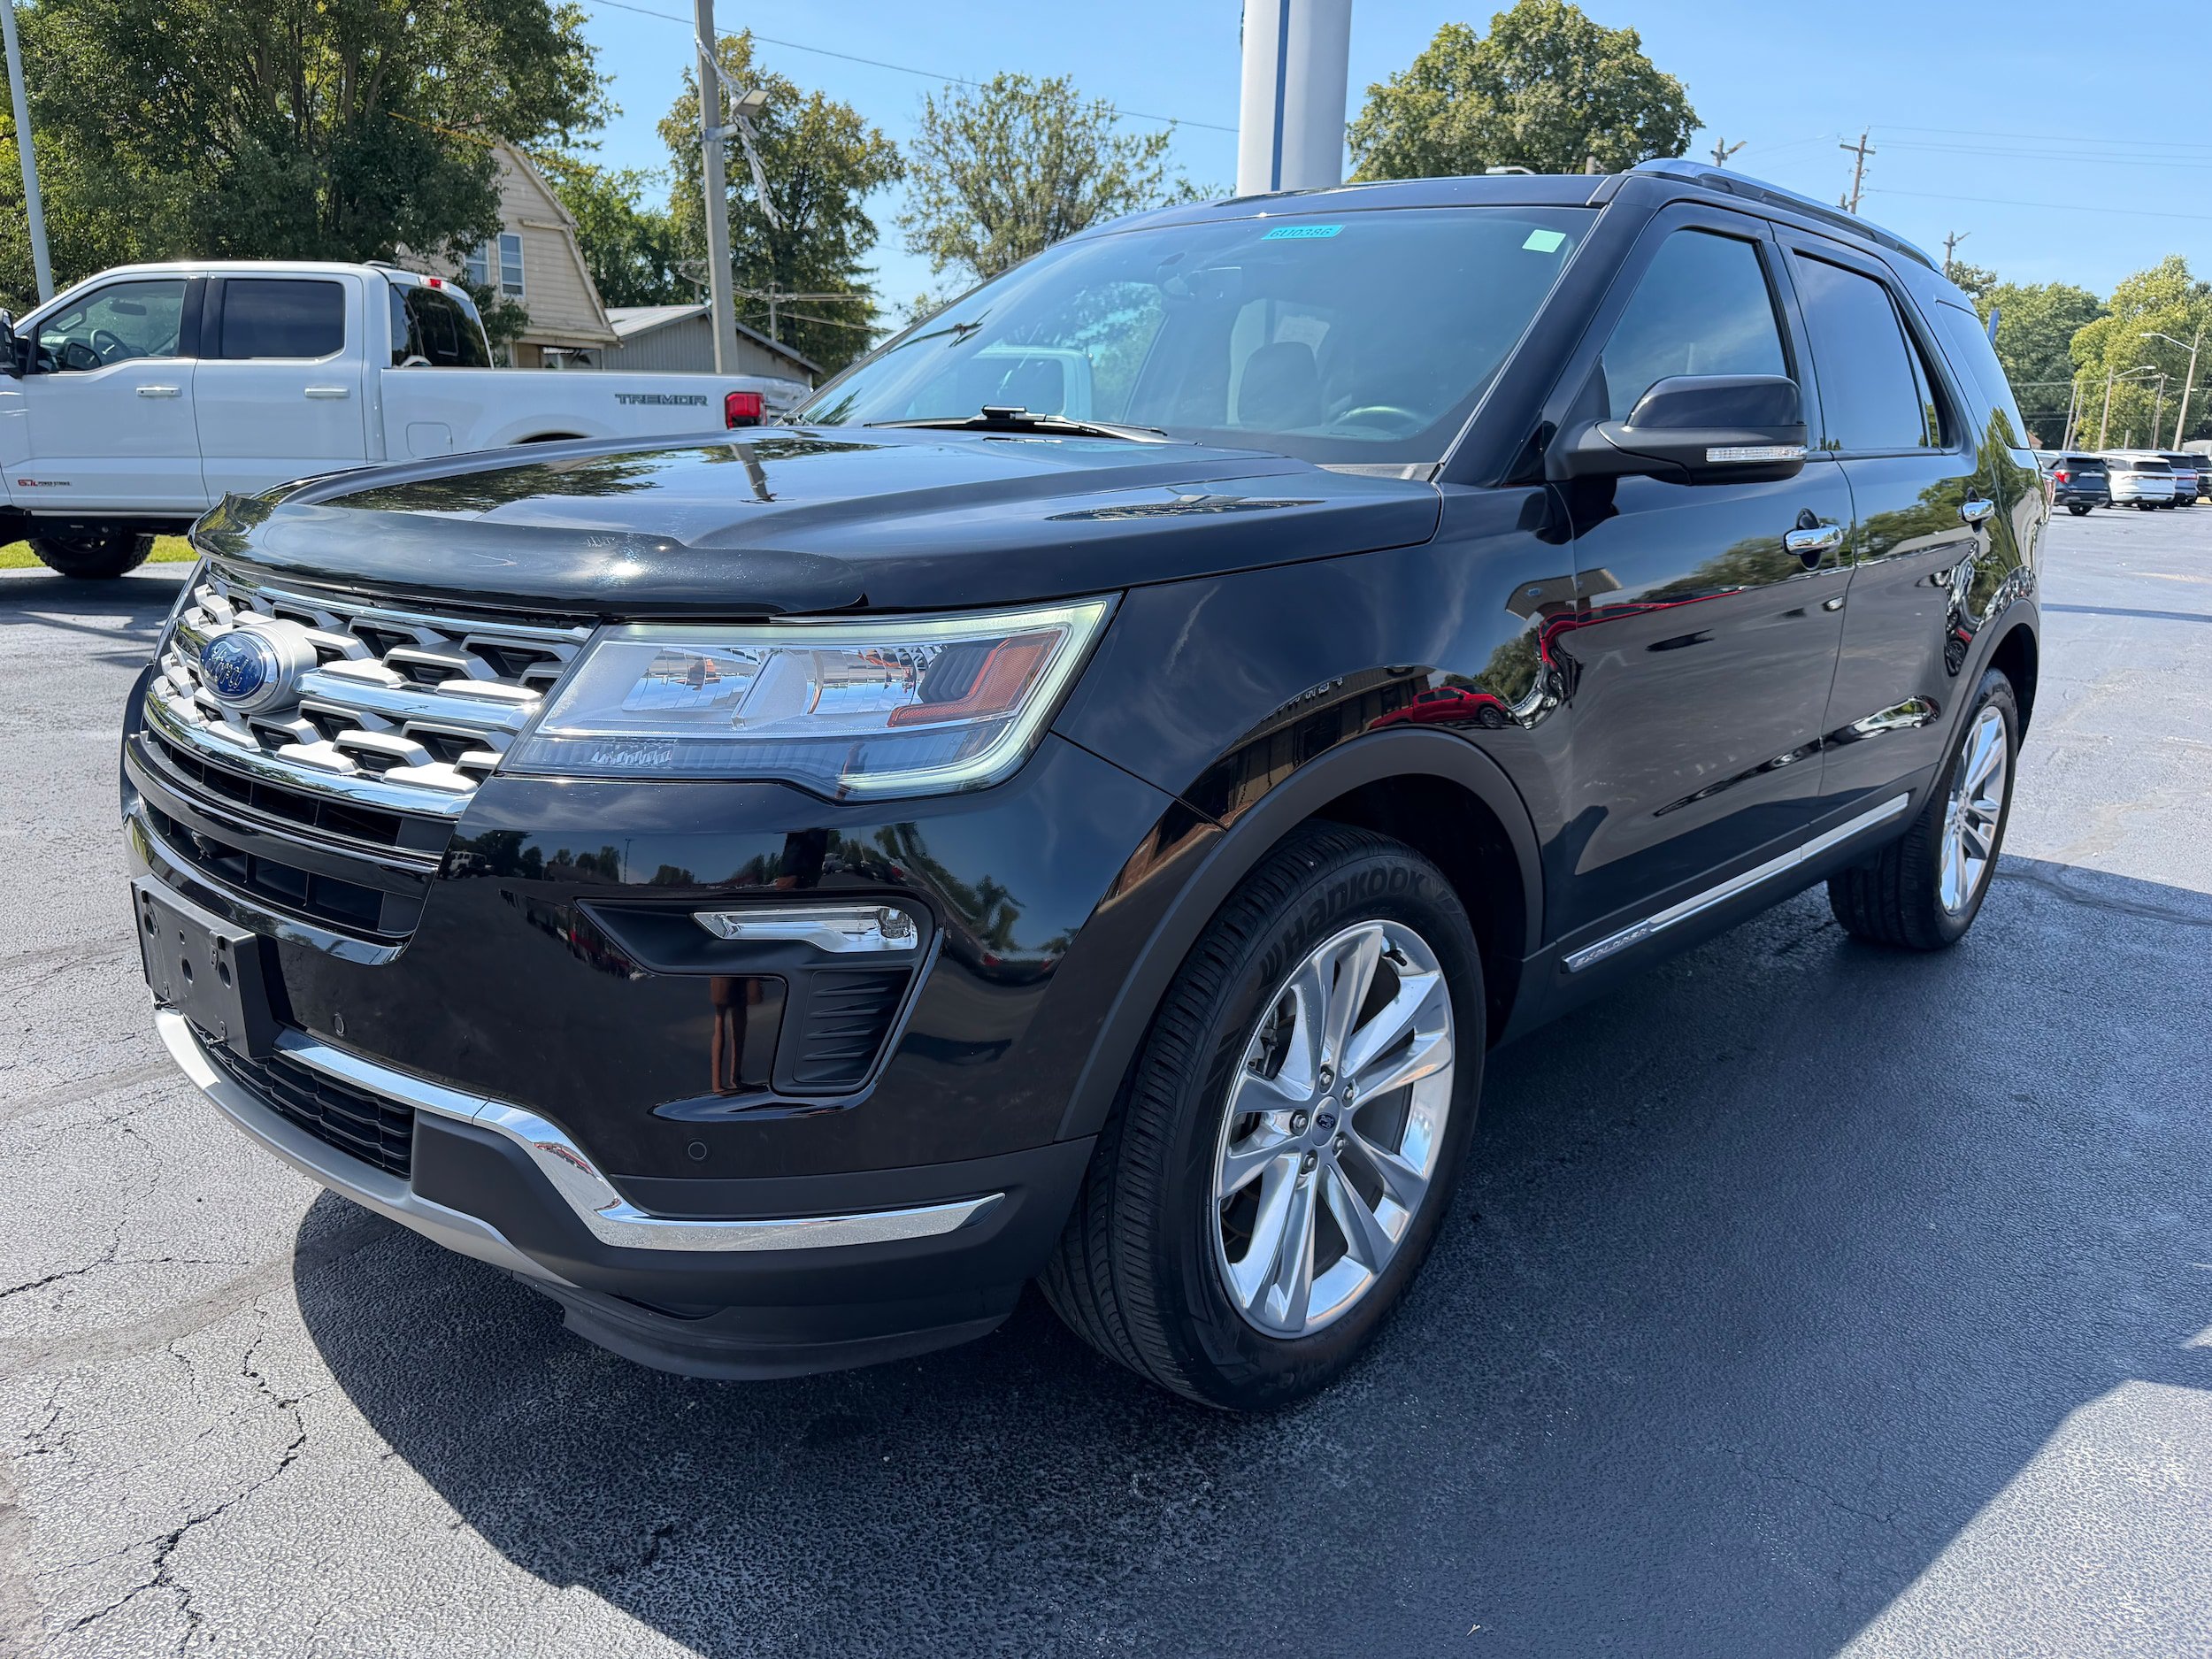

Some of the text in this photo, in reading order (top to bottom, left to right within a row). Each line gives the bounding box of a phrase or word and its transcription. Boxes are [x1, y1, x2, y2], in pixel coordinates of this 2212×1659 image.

[615, 394, 708, 406] TREMOR
[211, 641, 250, 689] Ford
[1573, 927, 1649, 968] EXPLORER
